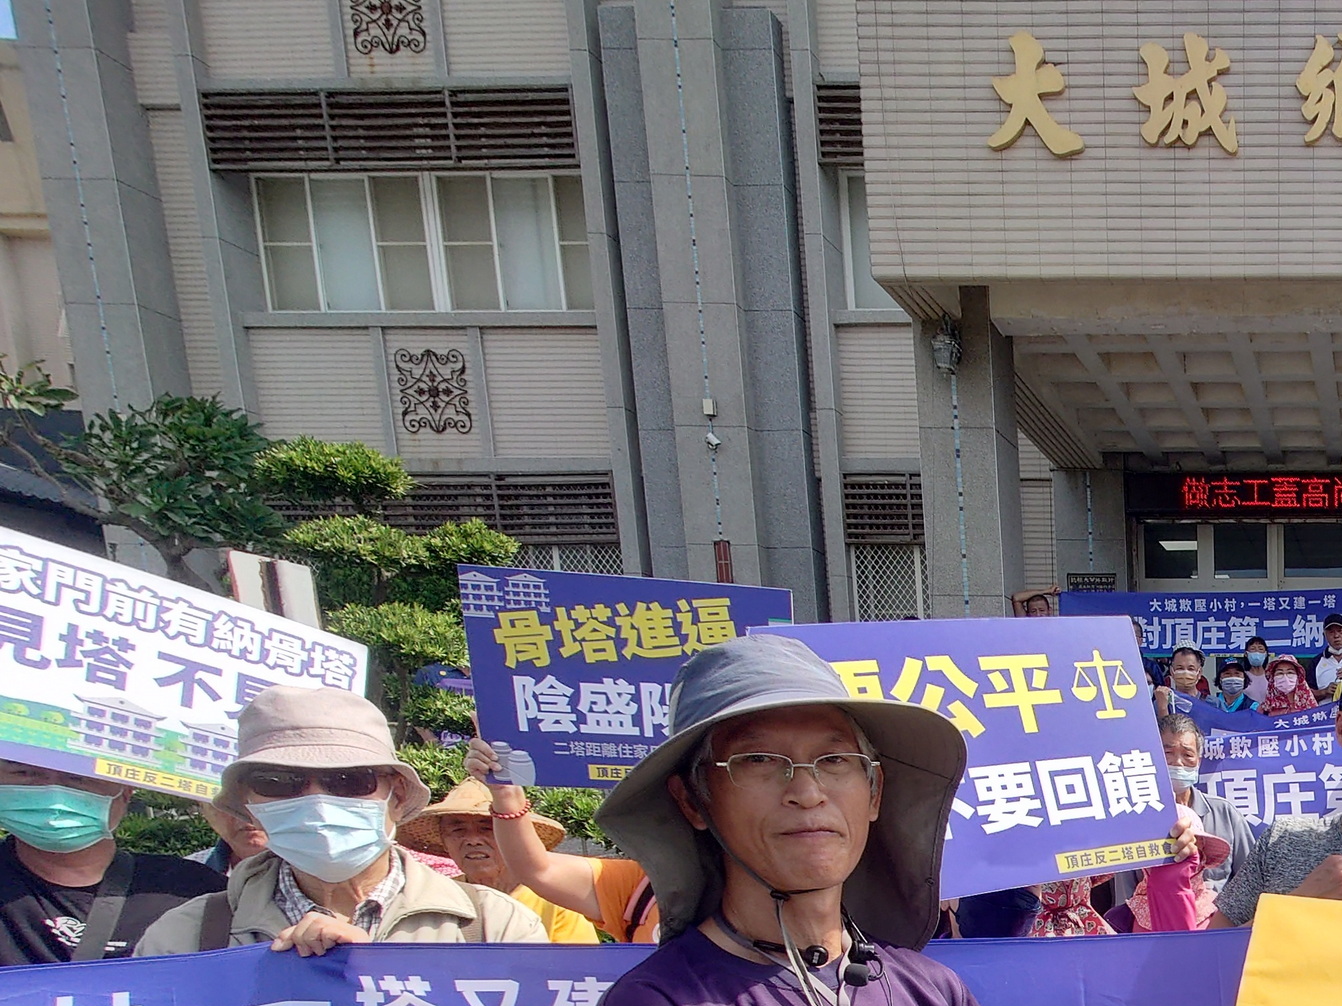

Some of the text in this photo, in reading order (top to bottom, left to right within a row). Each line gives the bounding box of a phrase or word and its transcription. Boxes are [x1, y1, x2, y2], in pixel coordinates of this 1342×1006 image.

[0, 544, 359, 692] 家門前有納骨塔
[1149, 594, 1337, 612] 大城欺壓小村，一塔又建一塔
[494, 597, 736, 669] 骨塔進逼
[1065, 842, 1174, 869] 頂庄反二塔自救會
